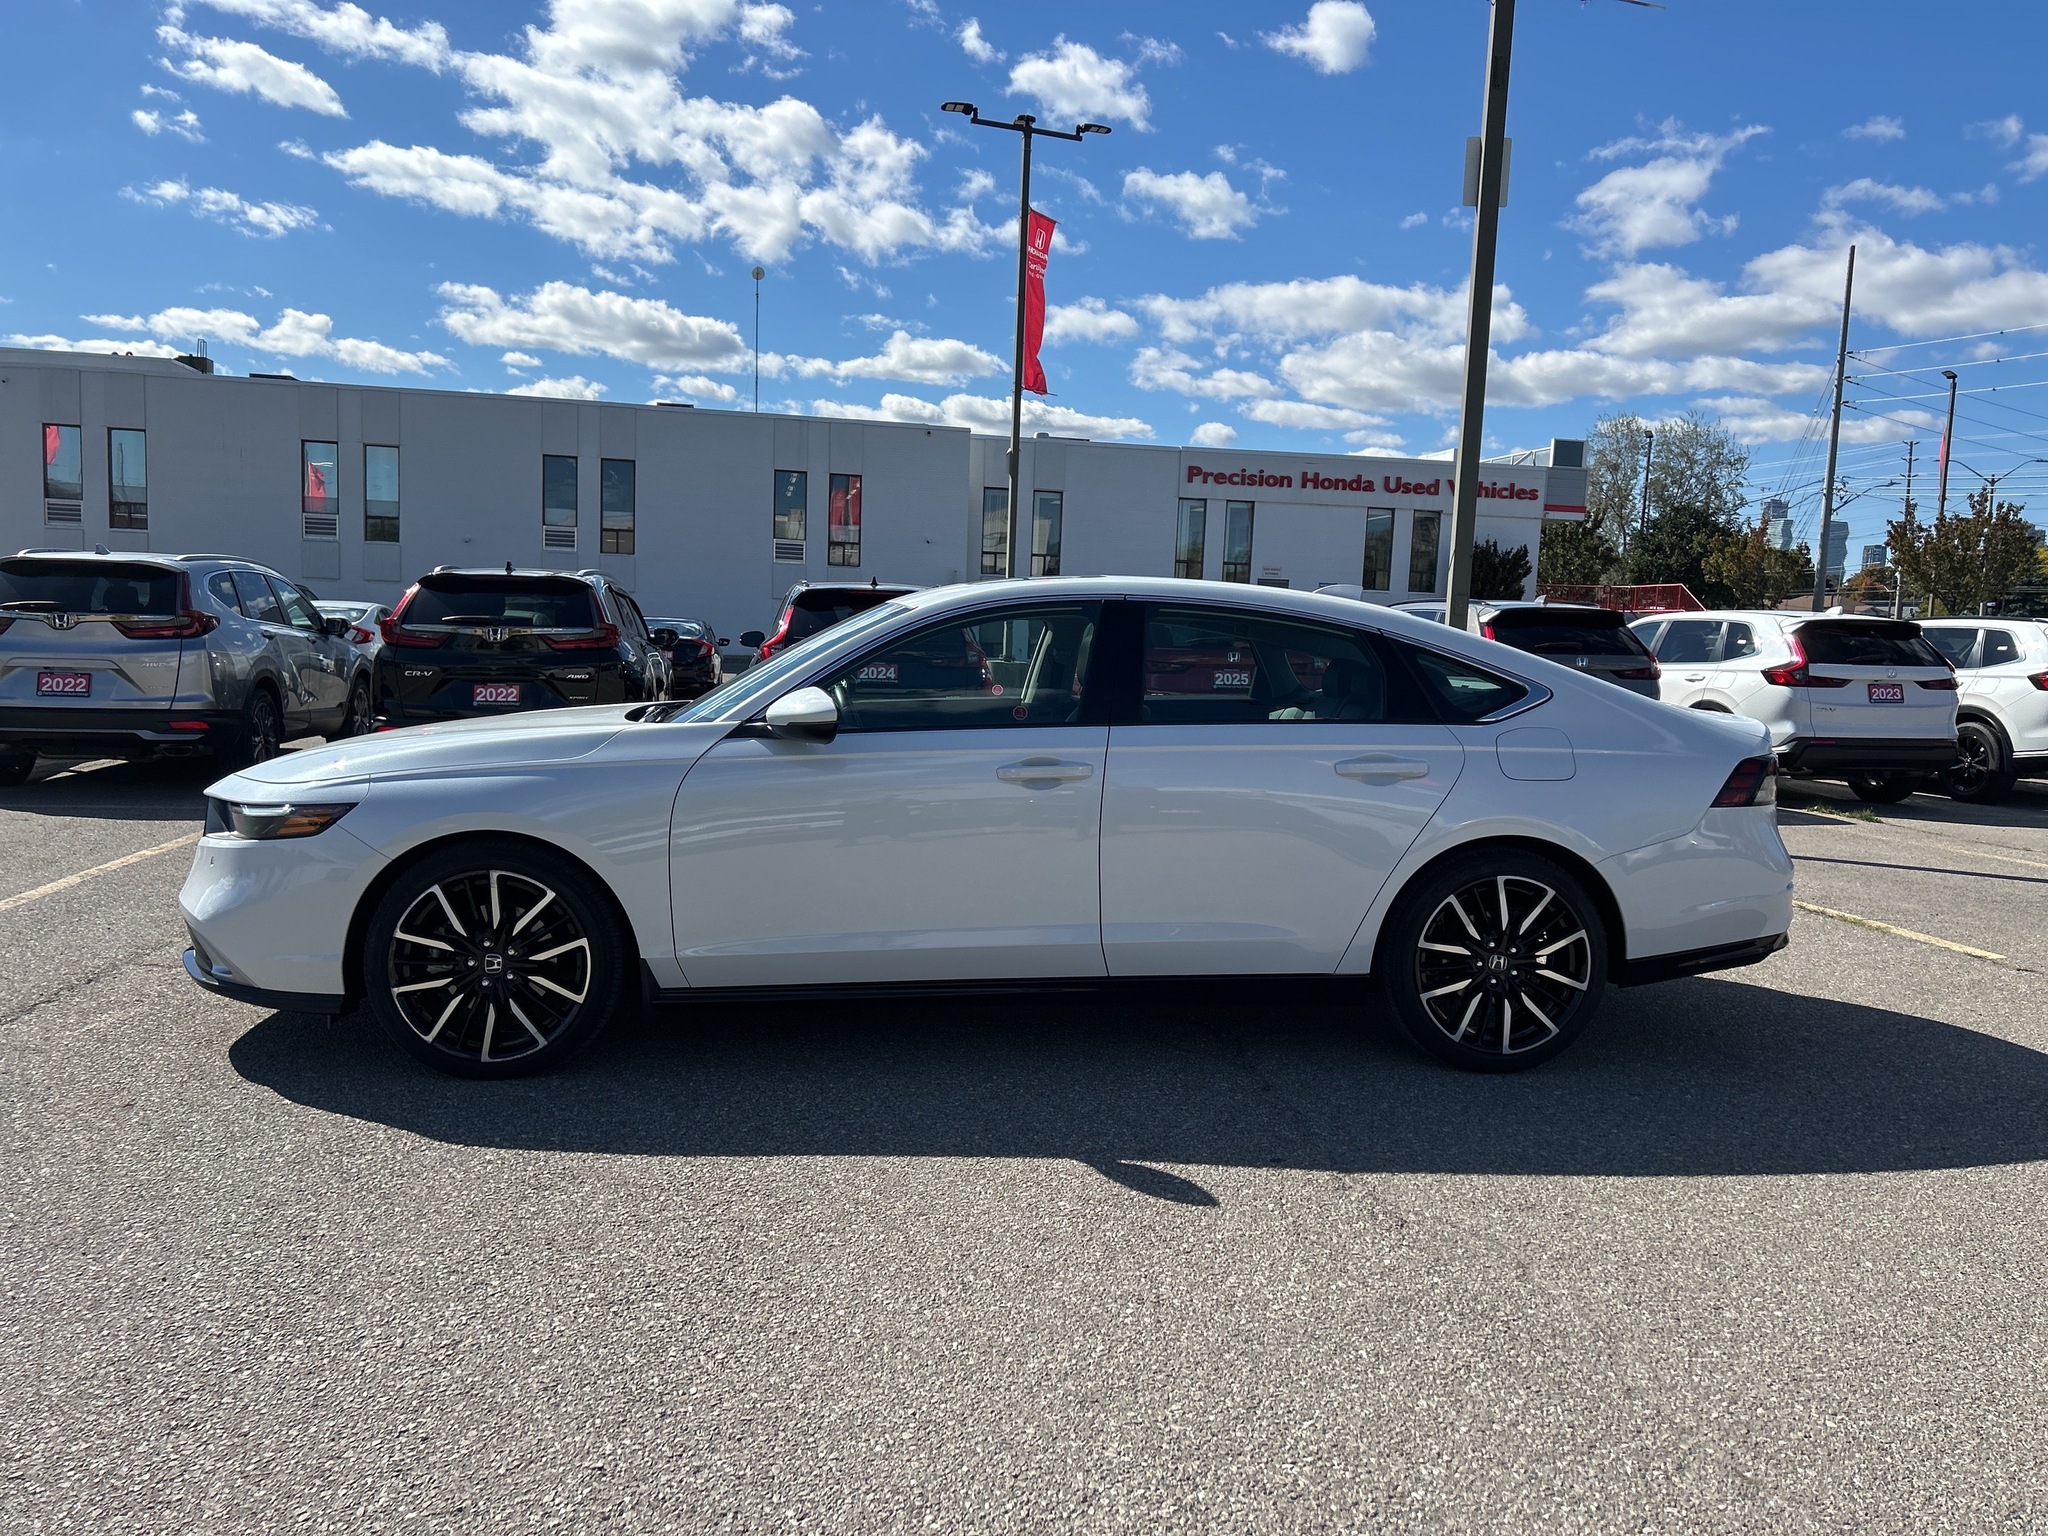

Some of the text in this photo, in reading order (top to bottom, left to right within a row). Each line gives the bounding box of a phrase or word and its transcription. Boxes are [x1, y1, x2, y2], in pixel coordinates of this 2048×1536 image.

[1187, 465, 1539, 500] Precision Honda Used hicles
[859, 667, 896, 680] 2024
[1215, 673, 1249, 685] 2025
[41, 677, 87, 692] 2022
[476, 688, 517, 701] 2022
[1871, 688, 1901, 700] 2023
